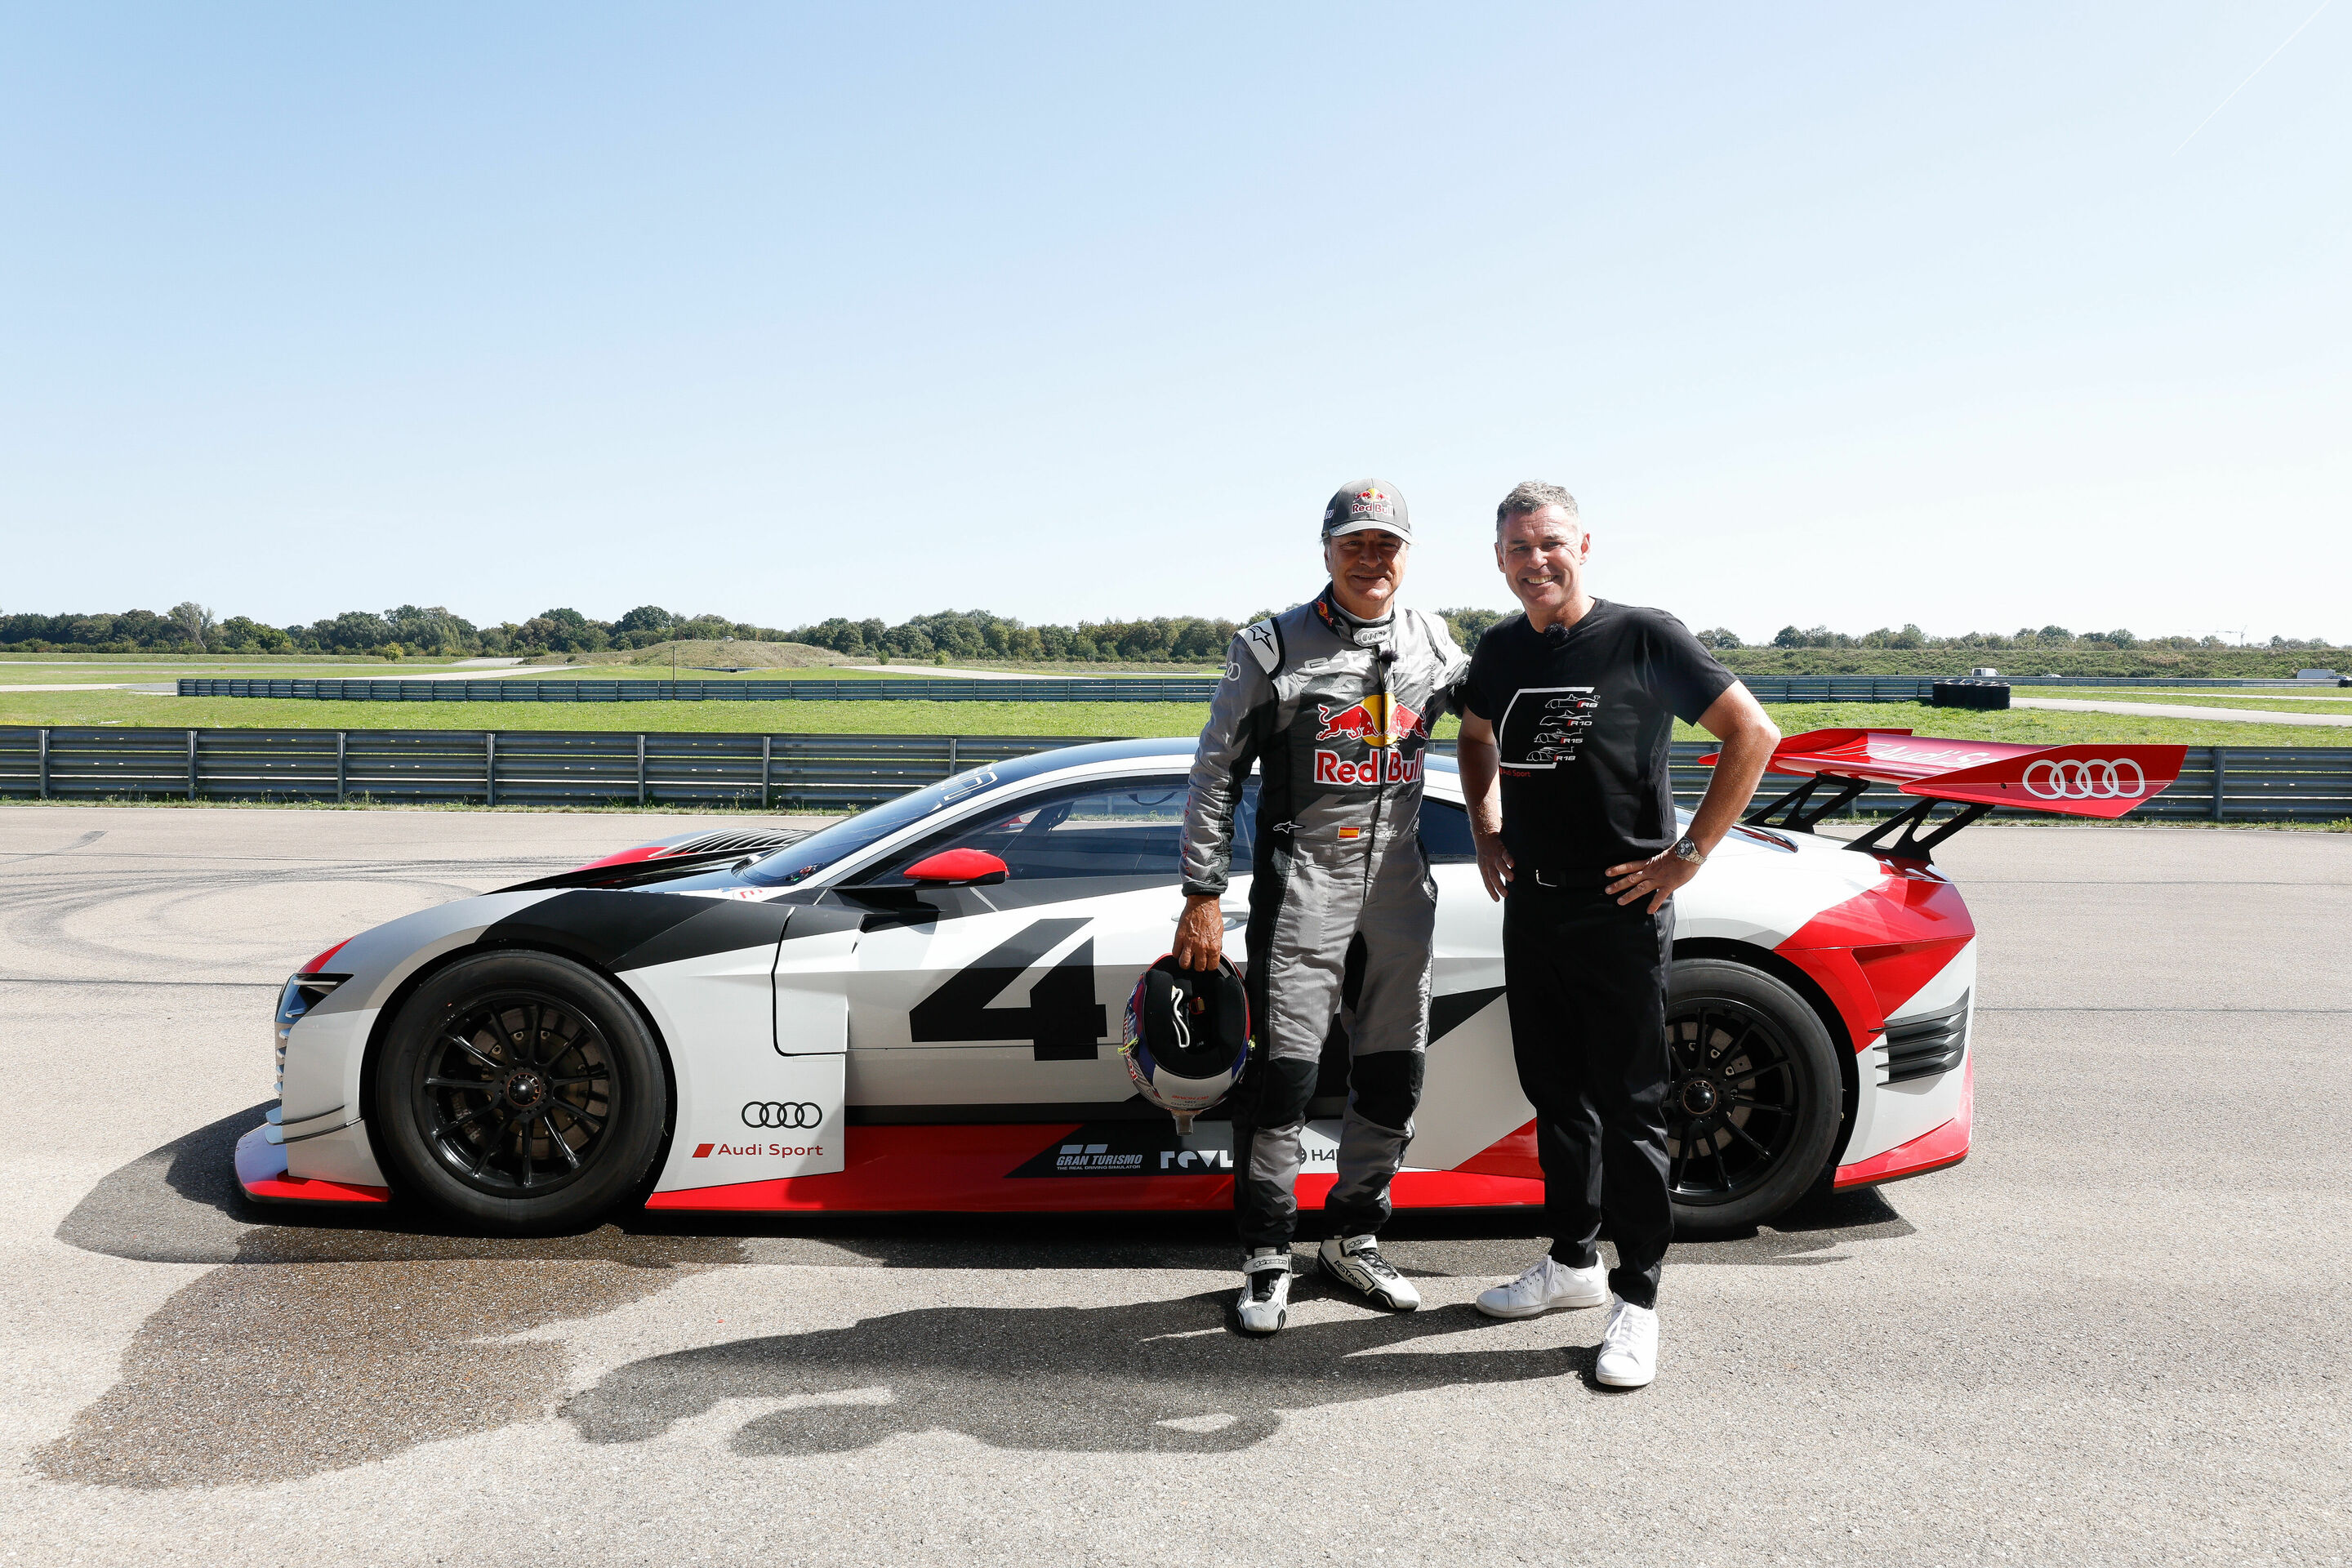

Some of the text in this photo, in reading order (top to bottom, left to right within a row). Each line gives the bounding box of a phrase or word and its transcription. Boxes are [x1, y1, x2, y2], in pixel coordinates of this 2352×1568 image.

[1352, 503, 1393, 516] Red Bull
[1860, 746, 1962, 763] Audi
[1315, 749, 1424, 786] Red Bull
[1512, 769, 1531, 777] Sport
[909, 917, 1107, 1062] 4
[718, 1143, 823, 1158] Audi Sport
[1056, 1154, 1143, 1166] GRAN TURISMO
